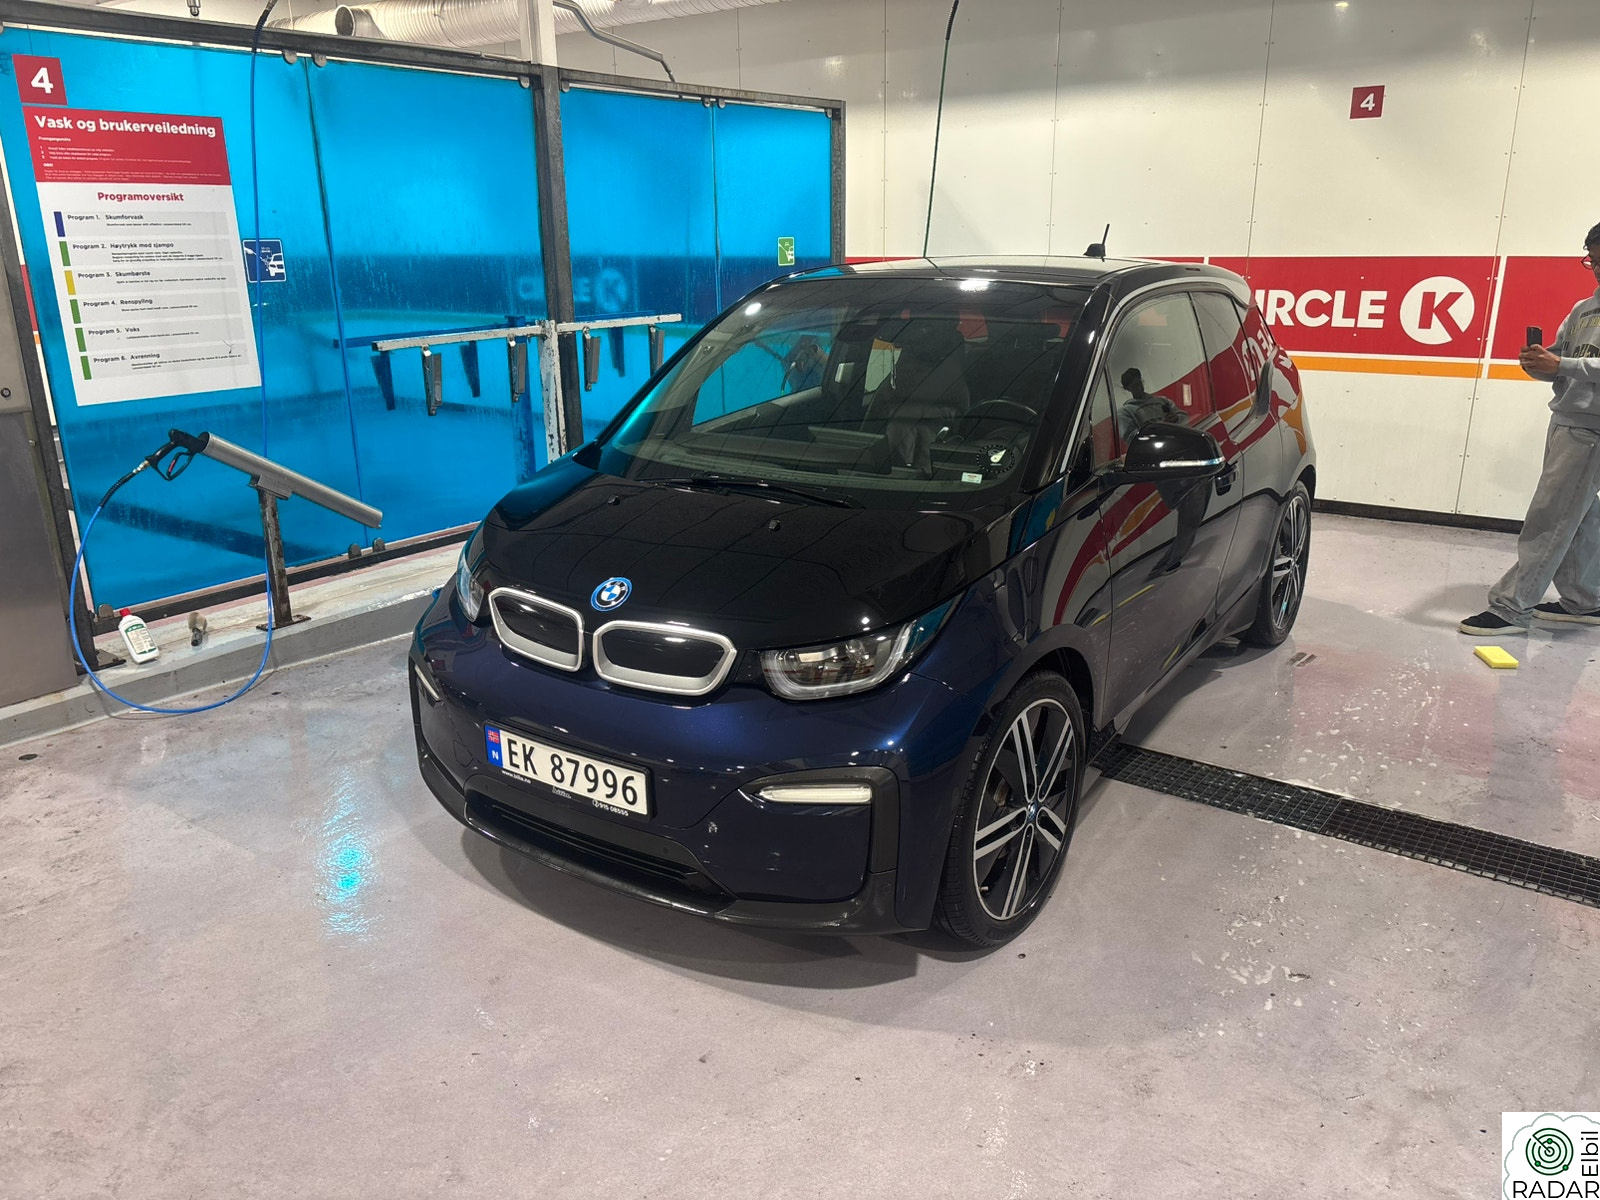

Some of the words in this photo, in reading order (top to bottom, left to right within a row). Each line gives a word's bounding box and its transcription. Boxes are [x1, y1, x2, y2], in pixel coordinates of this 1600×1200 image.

[30, 67, 54, 94] 4
[1360, 92, 1375, 111] 4
[34, 115, 73, 130] Vask
[76, 119, 97, 132] og
[100, 117, 216, 138] brukerveiledning
[97, 192, 184, 203] Programoversikt
[83, 300, 110, 308] Program
[1255, 289, 1388, 329] IRCLE
[88, 328, 115, 336] Program
[130, 352, 160, 360] Avrenning
[491, 750, 499, 760] N
[507, 738, 538, 775] EK
[550, 753, 638, 806] 87996
